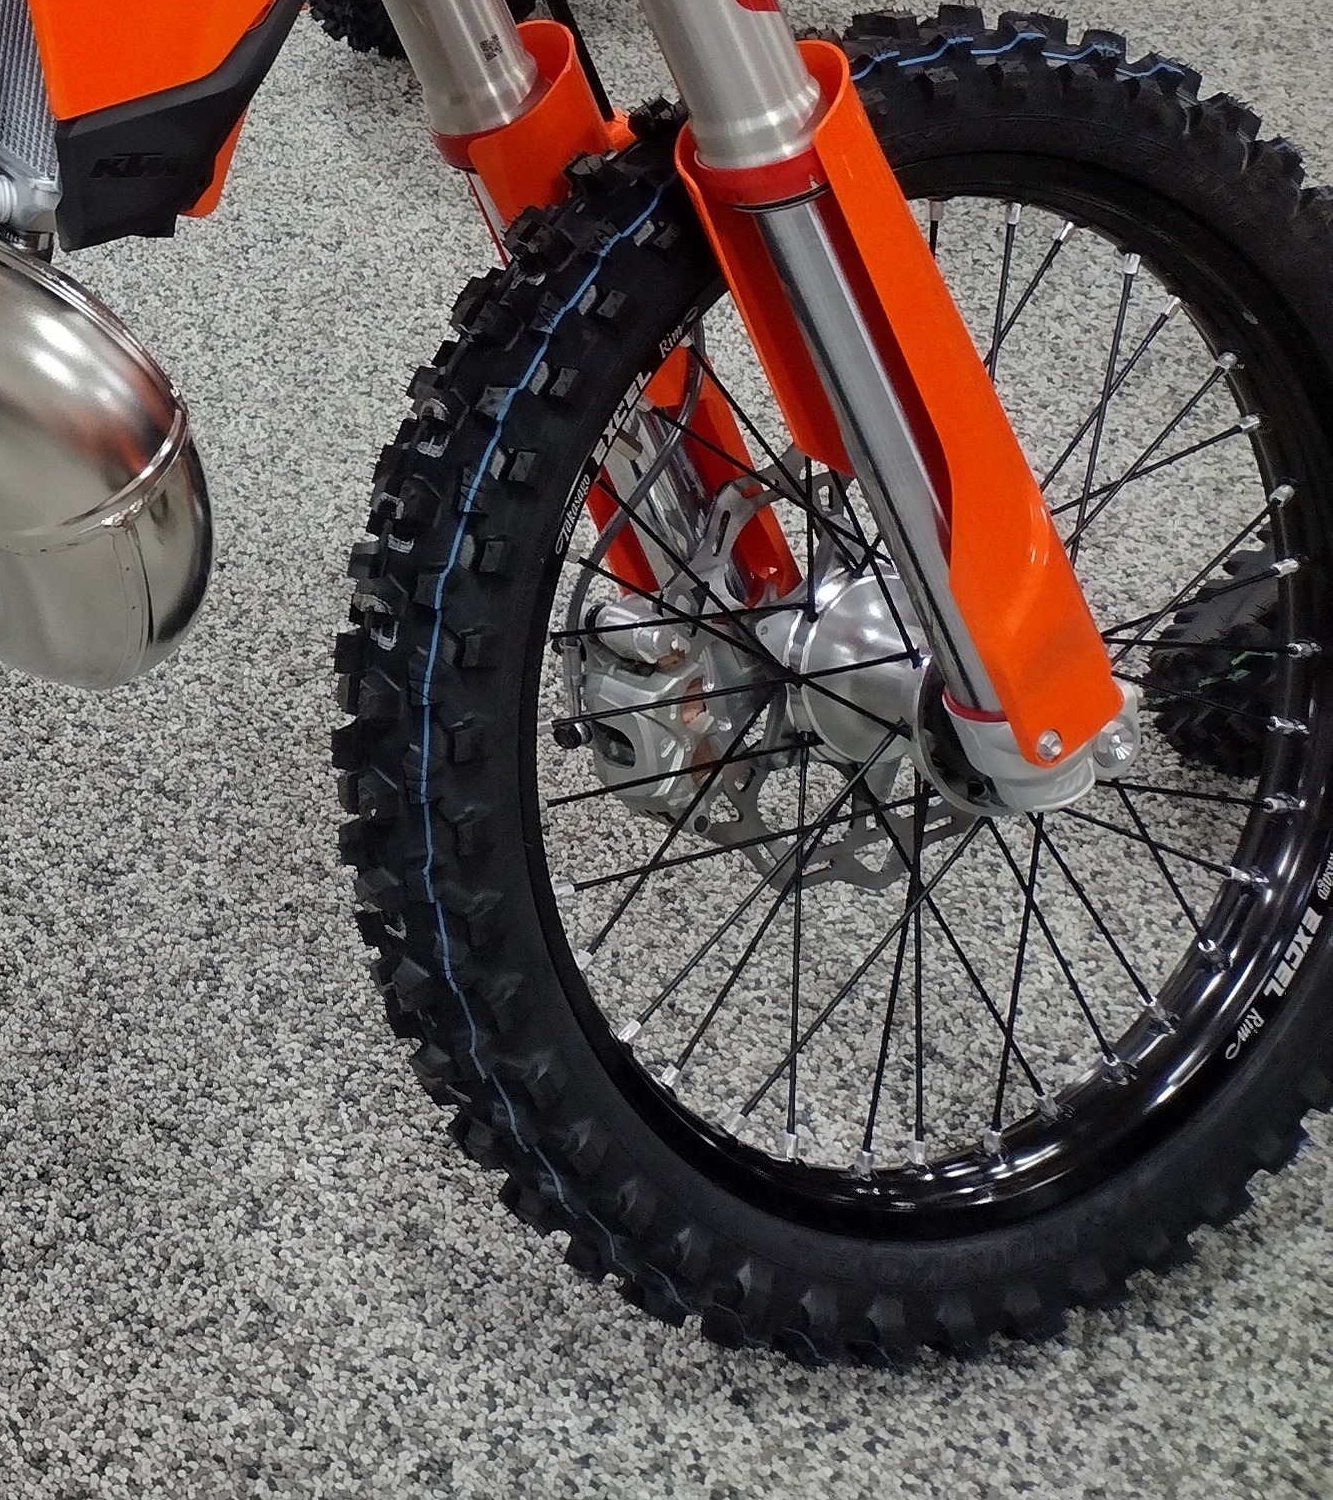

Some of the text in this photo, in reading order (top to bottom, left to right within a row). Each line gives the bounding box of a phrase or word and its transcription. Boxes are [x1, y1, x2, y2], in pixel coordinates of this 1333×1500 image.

[555, 305, 700, 556] Takasago EXCEL Rim
[1263, 906, 1324, 997] EXCEL
[1225, 1007, 1265, 1061] Rim
